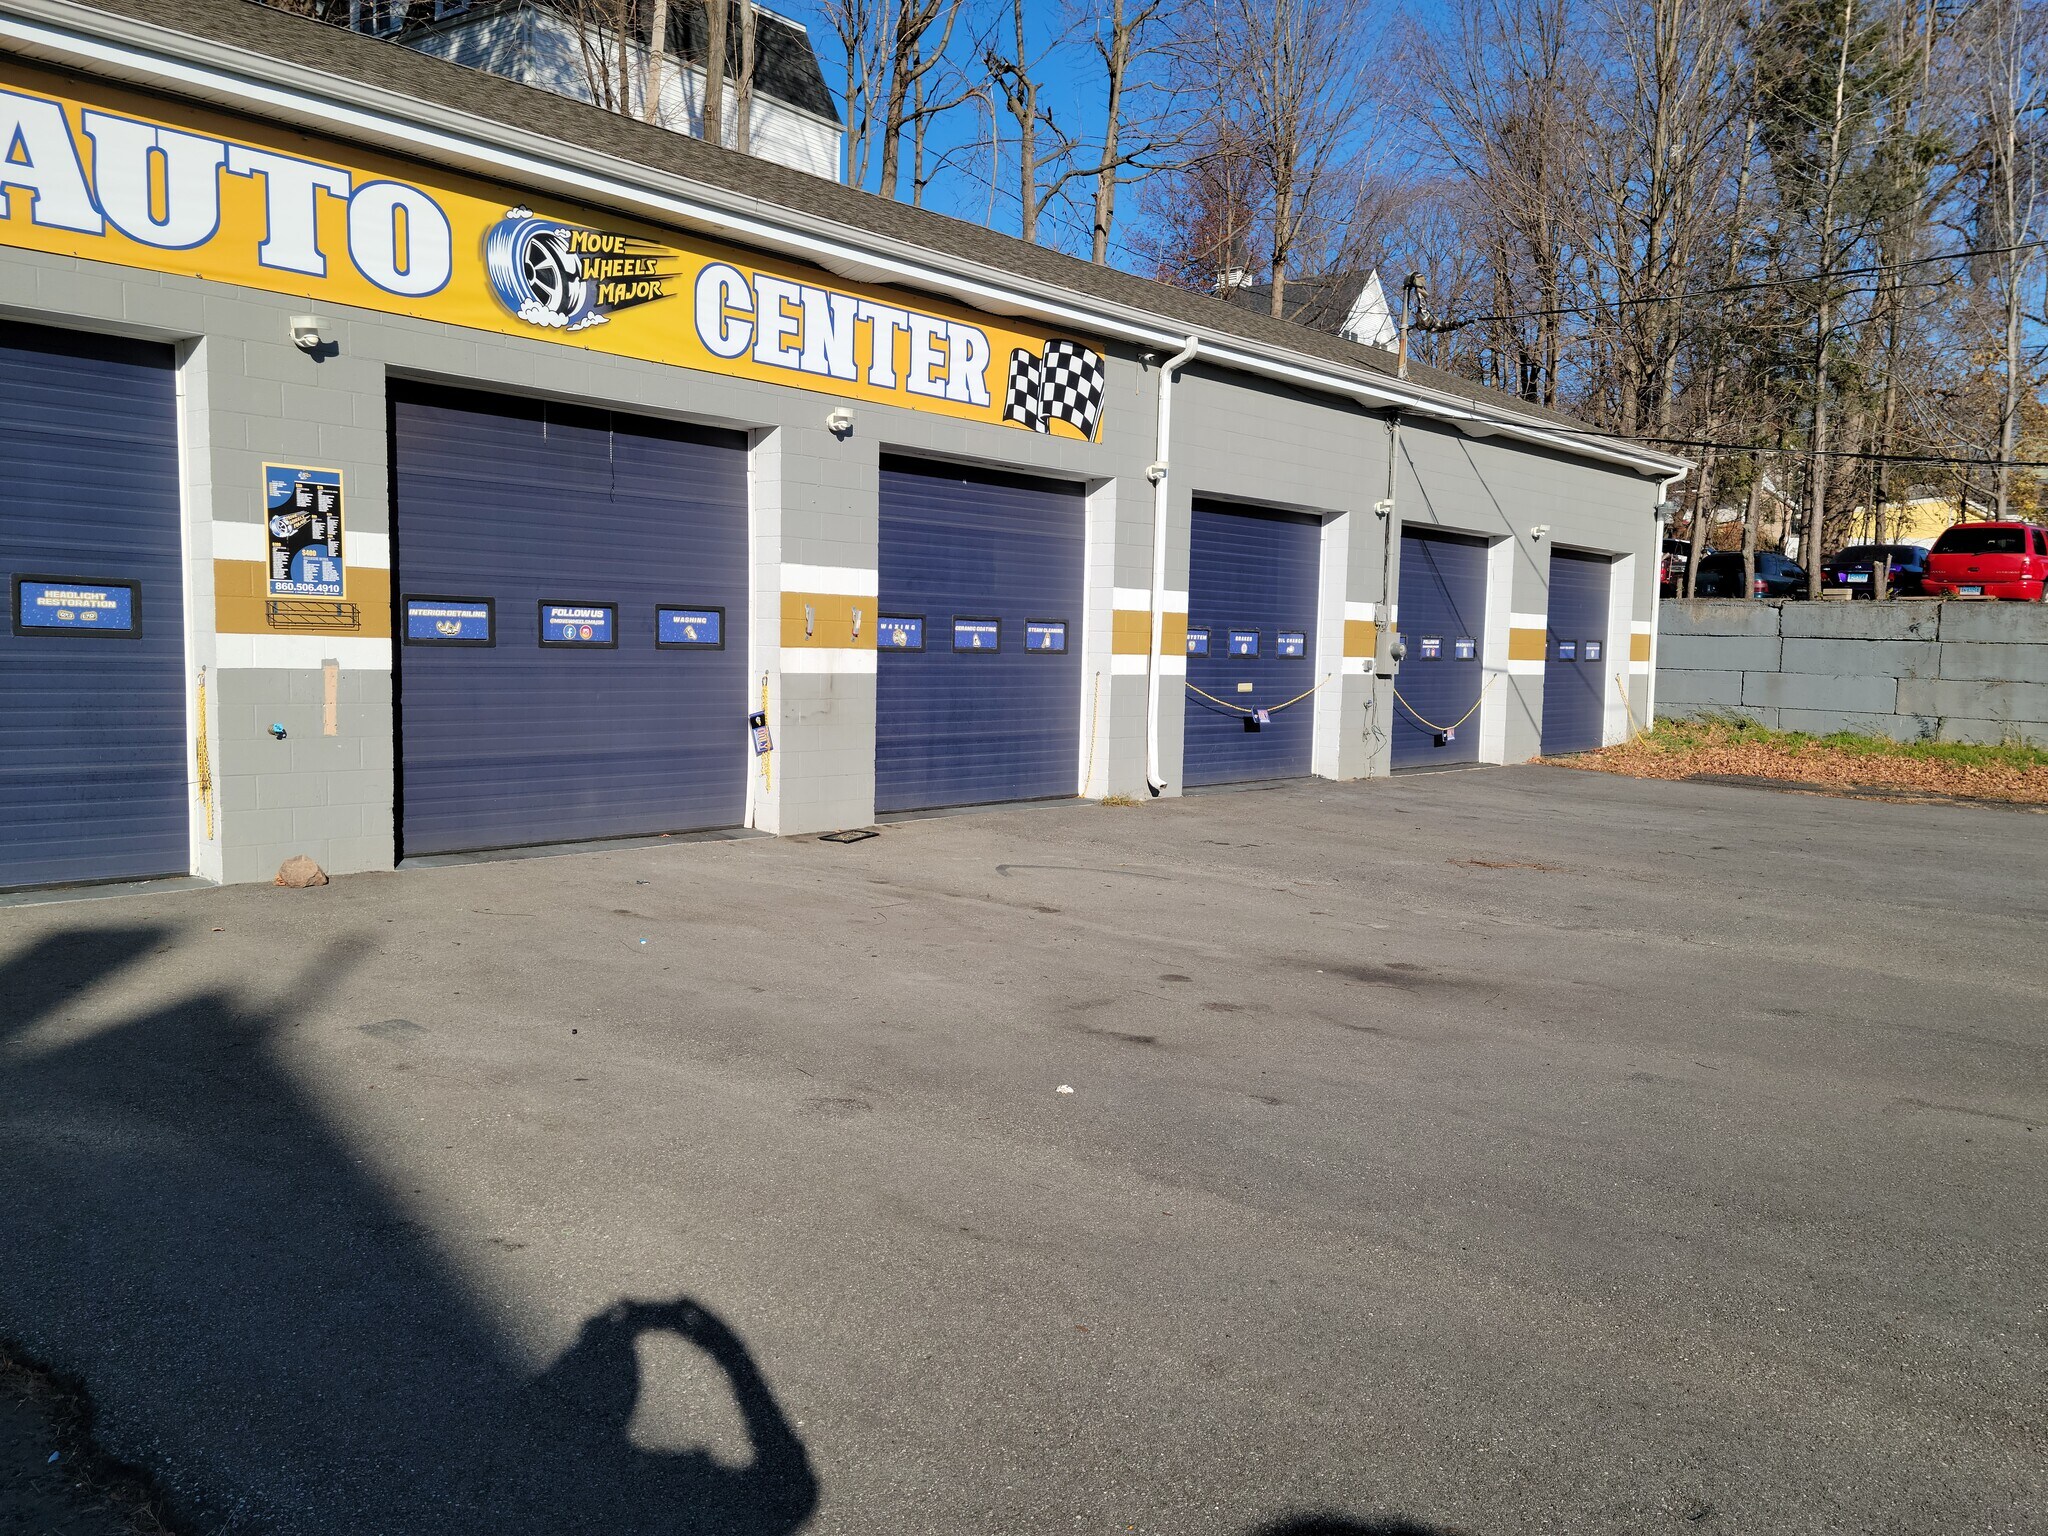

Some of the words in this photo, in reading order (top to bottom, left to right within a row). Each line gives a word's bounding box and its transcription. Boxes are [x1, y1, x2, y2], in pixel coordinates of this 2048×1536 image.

[0, 88, 453, 298] AUTO
[694, 262, 991, 407] CENTER
[568, 230, 626, 254] MOVE
[582, 258, 658, 281] WHEELS
[597, 281, 663, 306] MAJOR
[275, 582, 340, 593] 860.506.4910
[44, 590, 107, 600] HEADLIGHT
[37, 597, 117, 609] RESTORATION
[408, 608, 447, 617] INTERIOR
[447, 610, 486, 618] DETAILING
[551, 608, 590, 618] FOLLOW
[591, 609, 604, 618] US
[673, 616, 707, 625] WASHING
[880, 623, 916, 631] WAXING
